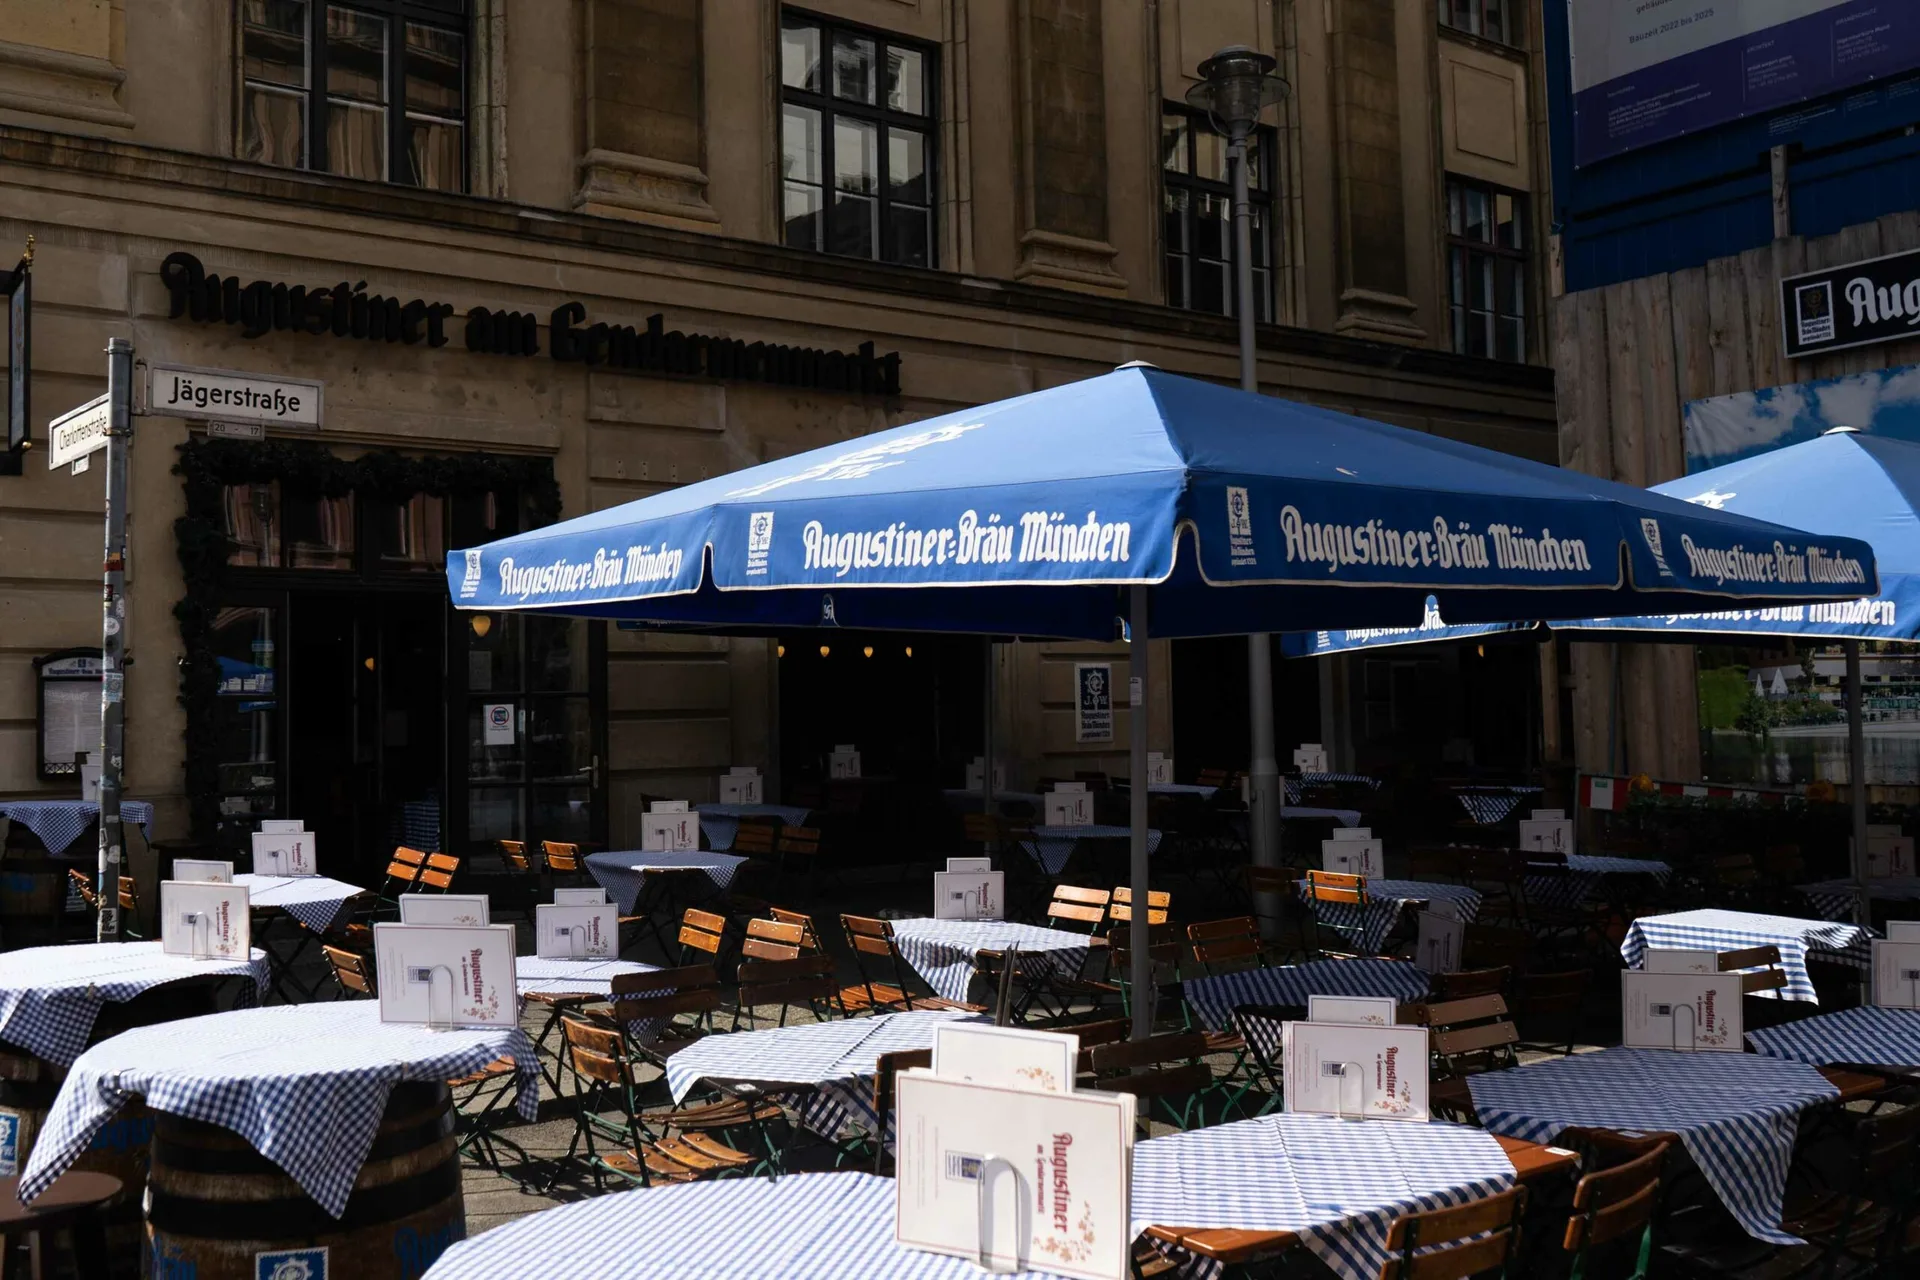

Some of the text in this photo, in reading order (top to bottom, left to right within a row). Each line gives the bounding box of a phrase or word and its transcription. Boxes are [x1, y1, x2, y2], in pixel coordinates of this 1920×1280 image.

[1628, 7, 1715, 44] Bauzeit 2022 bis 2025
[160, 252, 454, 348] Augustiner
[465, 306, 540, 356] am
[168, 376, 300, 416] Jägerstraße
[214, 422, 226, 432] 20
[250, 426, 260, 435] 17
[1018, 510, 1131, 563] München
[1488, 523, 1592, 572] München
[624, 542, 684, 585] München
[1806, 545, 1866, 584] München
[469, 948, 484, 1005] Augustiner
[1384, 1046, 1399, 1099] Augustiner
[1050, 1132, 1074, 1234] Augustiner
